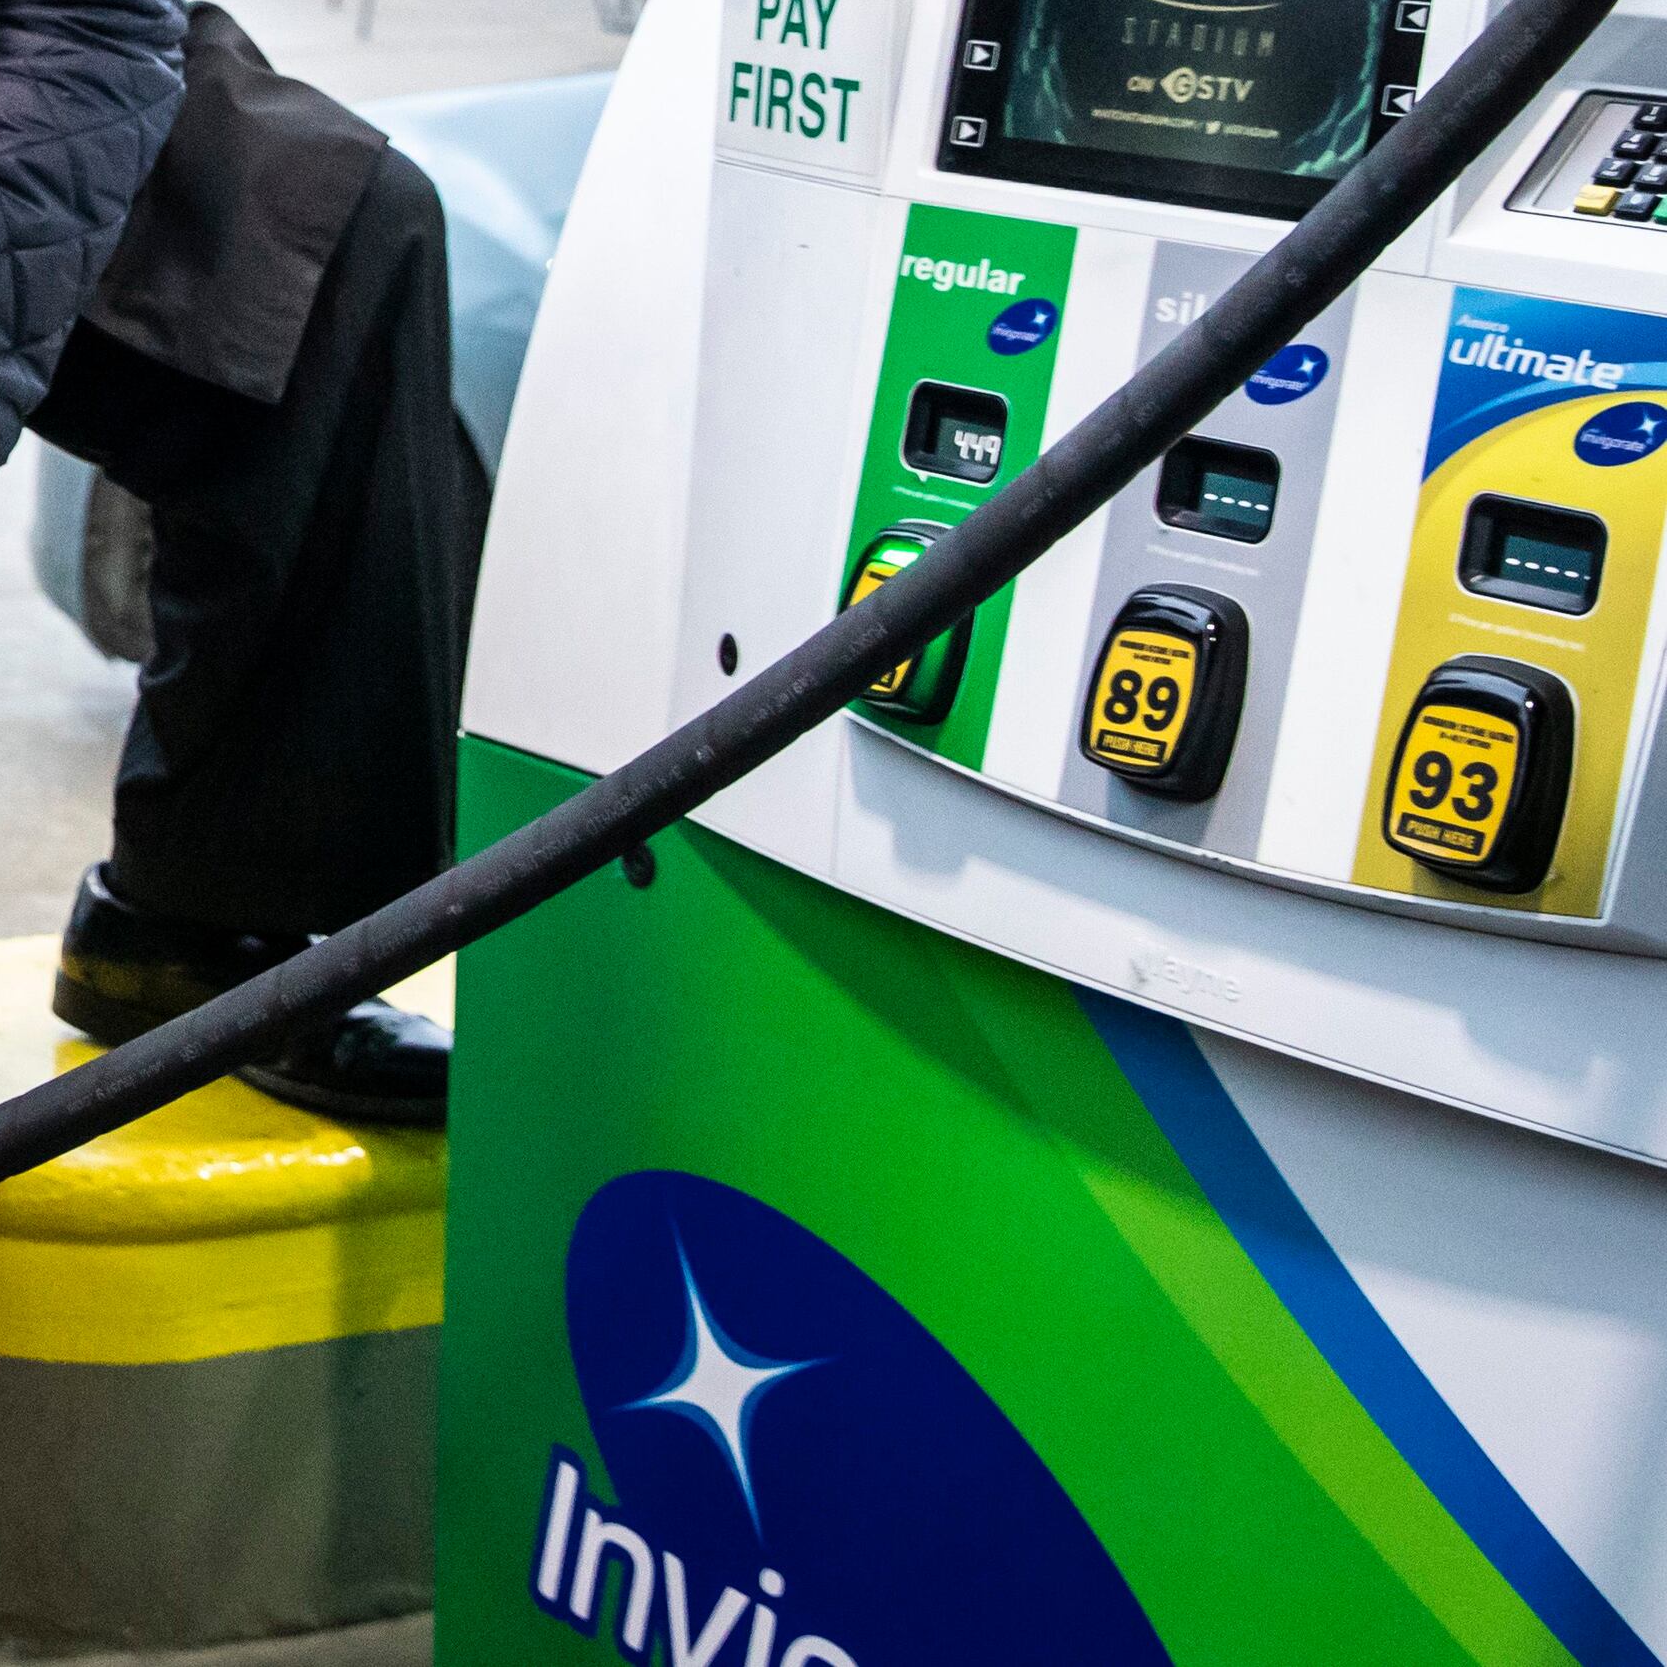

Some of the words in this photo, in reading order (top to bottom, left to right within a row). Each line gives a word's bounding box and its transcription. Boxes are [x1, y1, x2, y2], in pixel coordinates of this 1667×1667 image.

[728, 61, 862, 143] FIRST
[900, 253, 1026, 296] regular
[1154, 291, 1207, 326] sil
[1448, 333, 1625, 390] ultimate
[1103, 669, 1180, 732] 89
[1409, 750, 1499, 822] 93
[1405, 820, 1440, 839] PUSH
[1443, 830, 1477, 850] HERE
[536, 1460, 861, 1667] Invi
